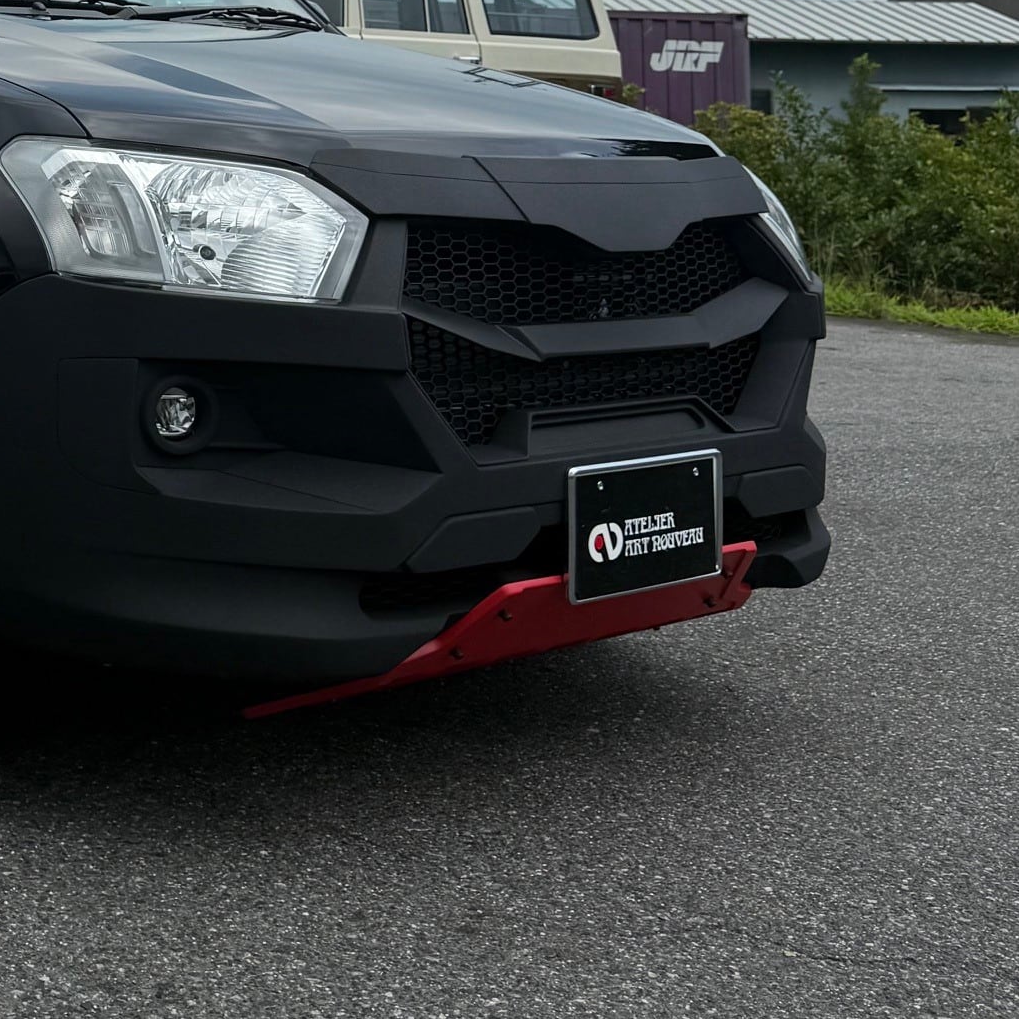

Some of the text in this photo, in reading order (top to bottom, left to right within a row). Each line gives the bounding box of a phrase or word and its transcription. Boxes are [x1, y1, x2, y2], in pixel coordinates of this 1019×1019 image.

[649, 39, 725, 73] JRF
[624, 527, 704, 557] ART NOUVEAU
